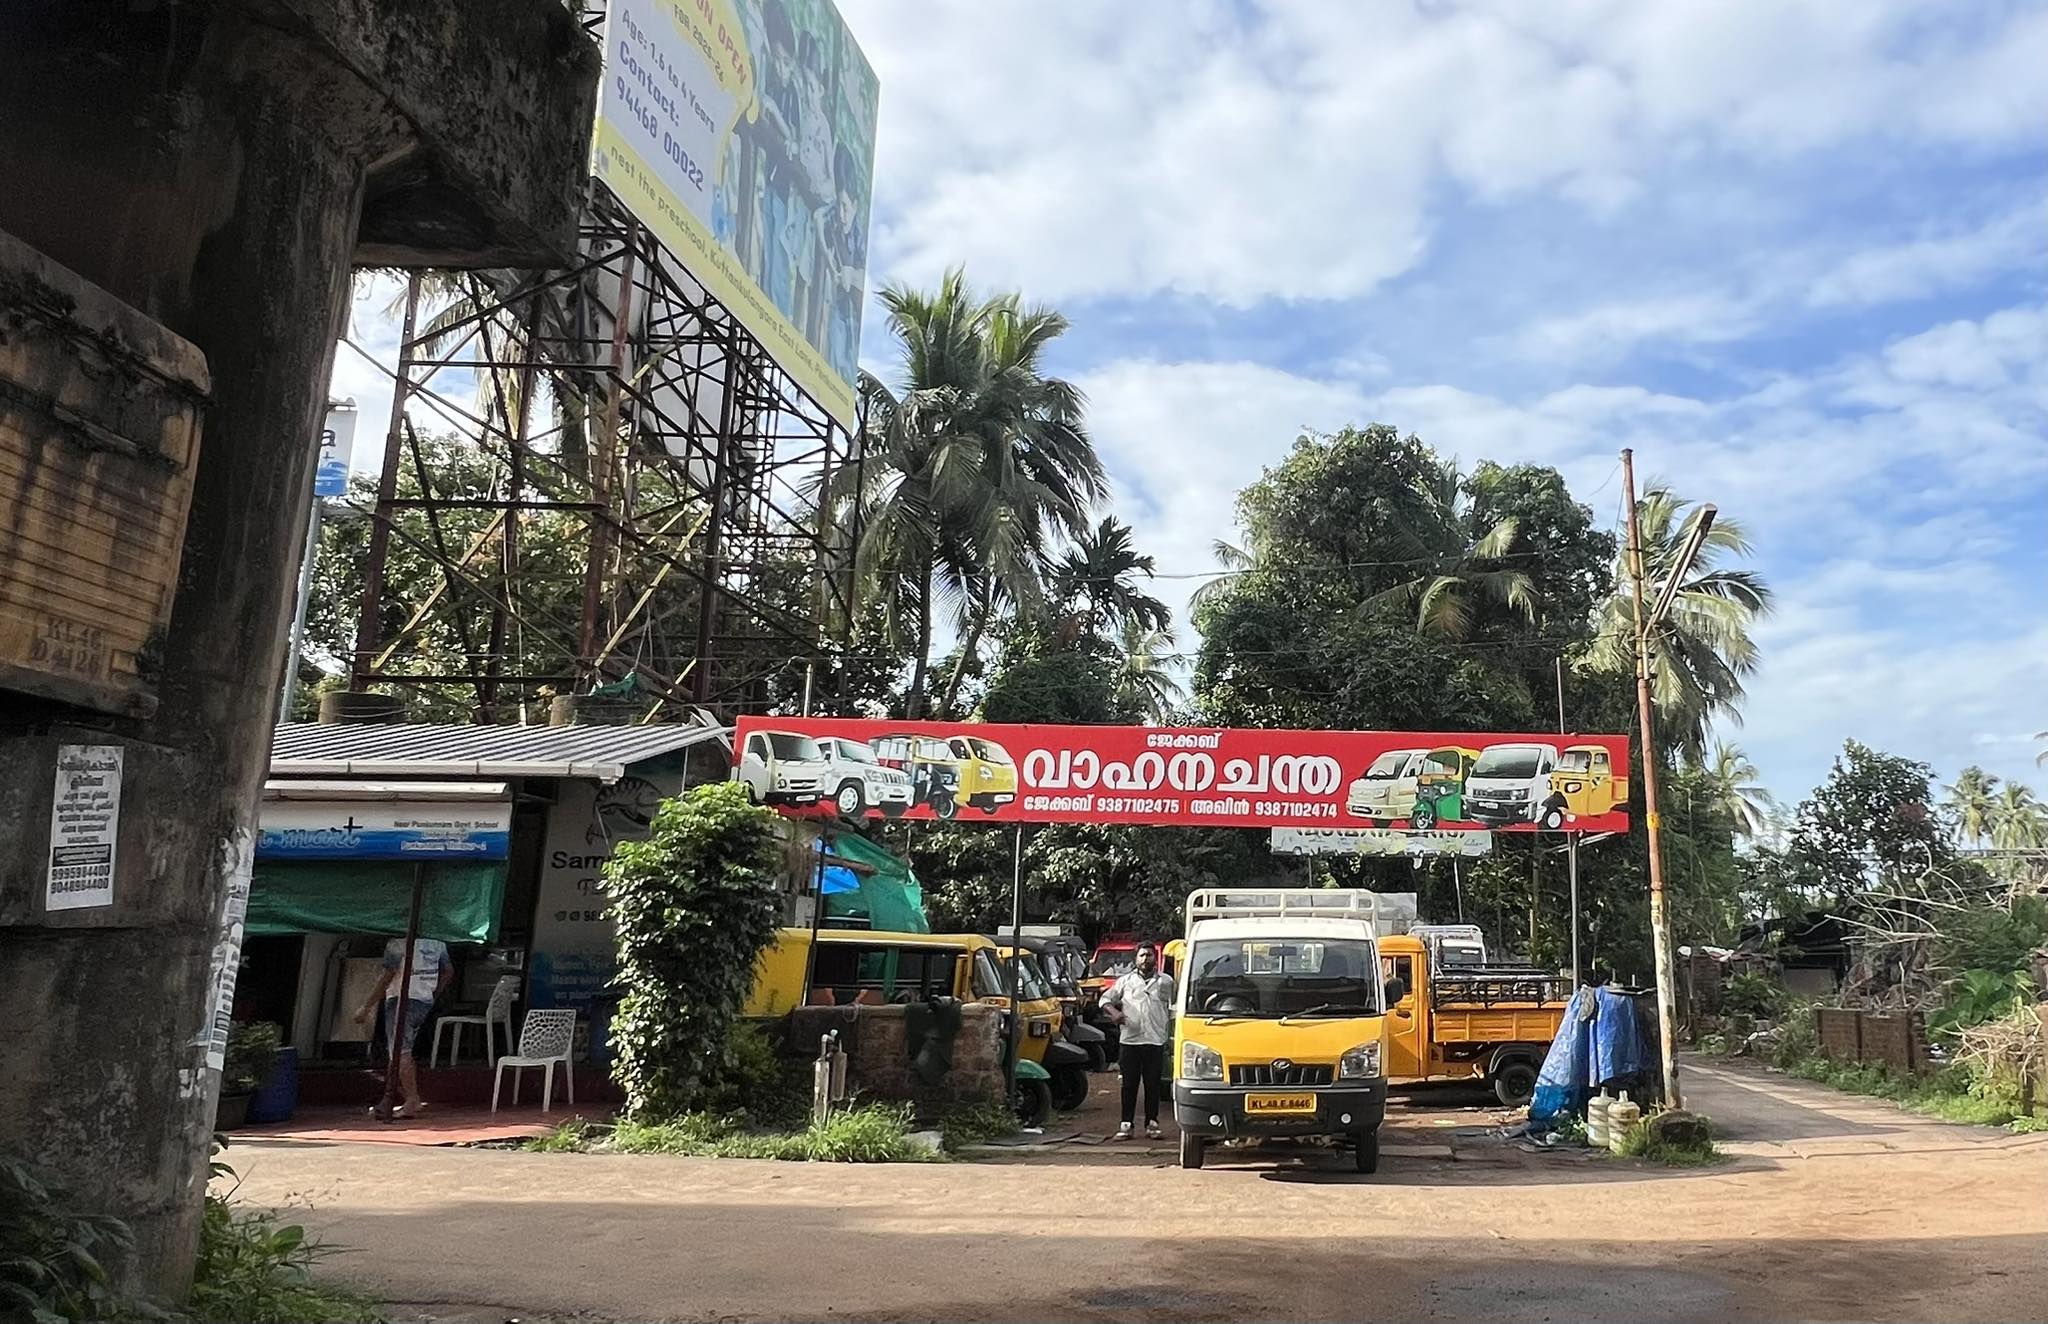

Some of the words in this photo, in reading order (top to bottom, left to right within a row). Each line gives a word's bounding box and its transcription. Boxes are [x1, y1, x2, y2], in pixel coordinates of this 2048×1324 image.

[620, 40, 680, 128] Contact:
[622, 9, 648, 50] Age:
[650, 42, 665, 71] 1.6
[667, 63, 679, 88] to
[681, 81, 687, 99] 4
[689, 89, 715, 134] Years
[673, 3, 690, 31] FOR
[692, 24, 724, 82] 2025-26
[718, 23, 747, 85] OPEN
[617, 75, 658, 139] 94468
[664, 131, 704, 193] 00022
[611, 146, 635, 178] nest
[639, 171, 656, 201] the
[658, 196, 708, 259] preschool,
[1147, 732, 1222, 749] ജേക്കബ്
[1024, 794, 1094, 811] ജേക്കബ്
[1097, 797, 1180, 814] 9387102475
[1255, 801, 1337, 818] 9387102474
